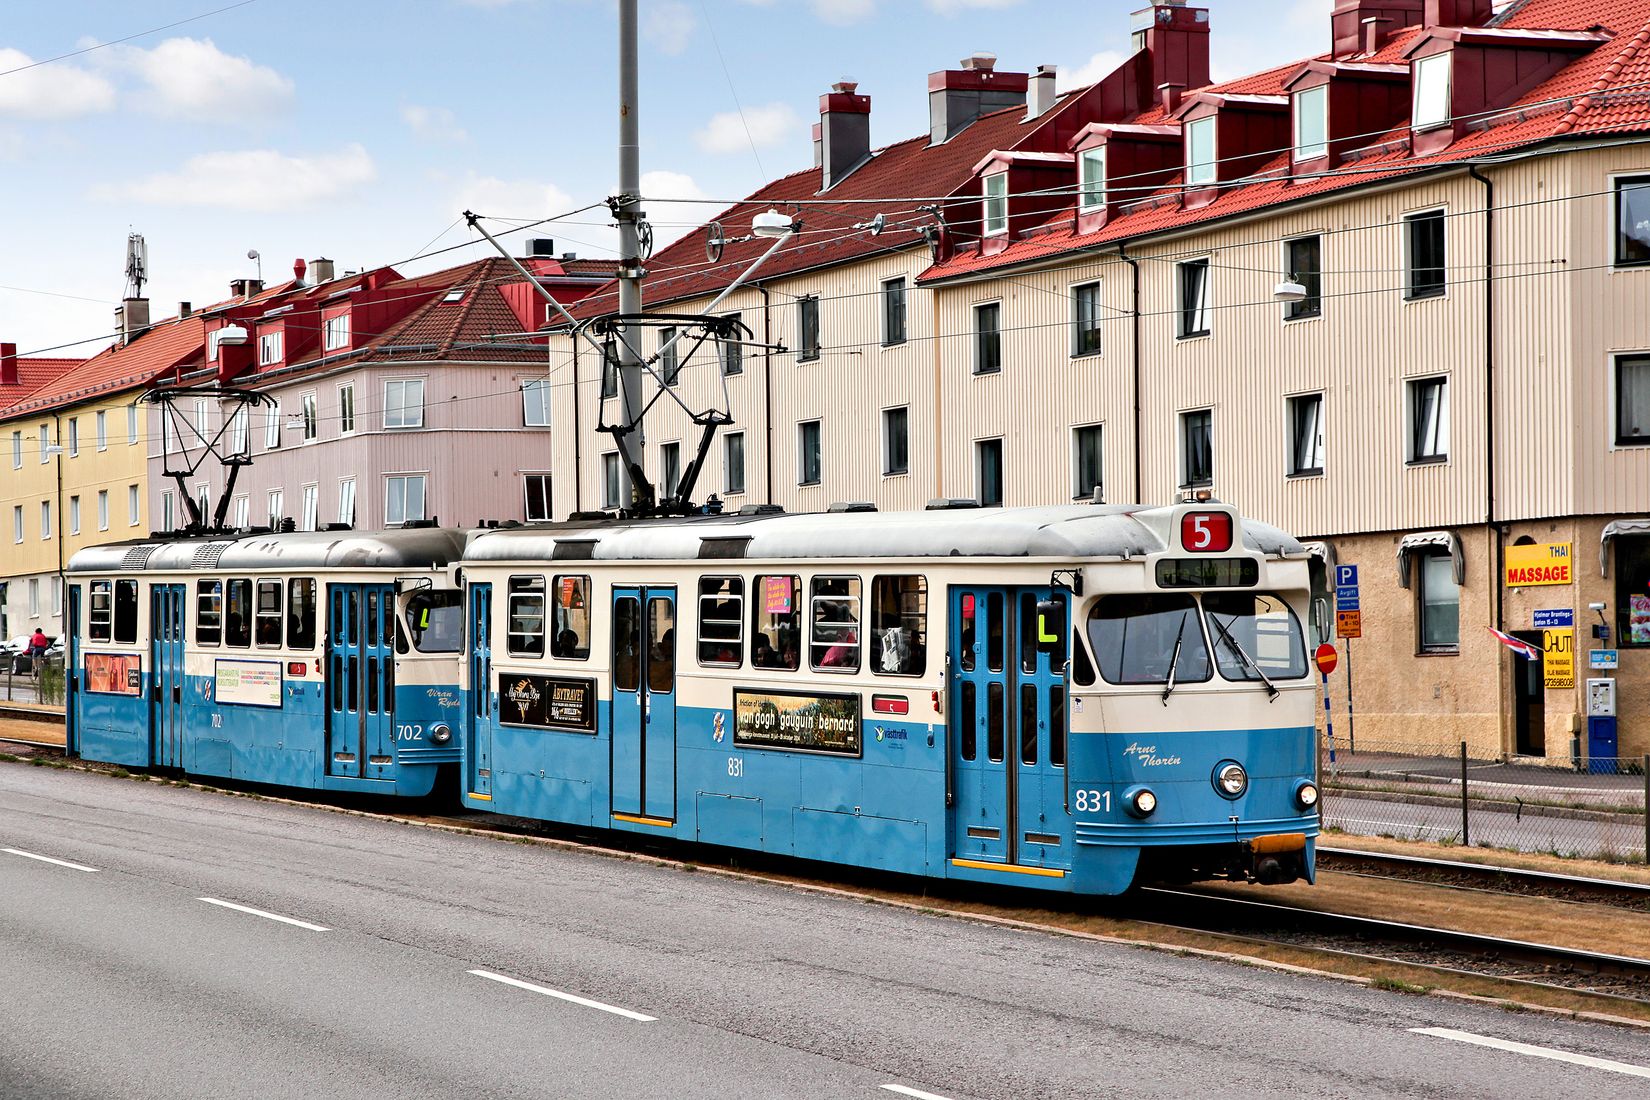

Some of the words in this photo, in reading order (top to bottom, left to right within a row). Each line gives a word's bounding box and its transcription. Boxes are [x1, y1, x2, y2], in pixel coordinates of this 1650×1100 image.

[1194, 516, 1211, 548] 5
[1549, 545, 1568, 558] THAI
[1341, 567, 1353, 584] P
[1508, 565, 1569, 584] MASSAGE
[1339, 589, 1357, 598] Avgift
[426, 688, 453, 698] Viran
[552, 684, 585, 702] ÅBYTRAVET
[211, 713, 222, 728] 702
[739, 711, 754, 724] van
[754, 709, 776, 730] gogh
[780, 711, 814, 732] gauguin
[818, 712, 855, 732] bernard
[396, 724, 423, 741] 702
[1123, 742, 1156, 756] Arne
[728, 756, 743, 778] 831
[1138, 754, 1181, 767] Thorén
[1075, 789, 1111, 813] 831
